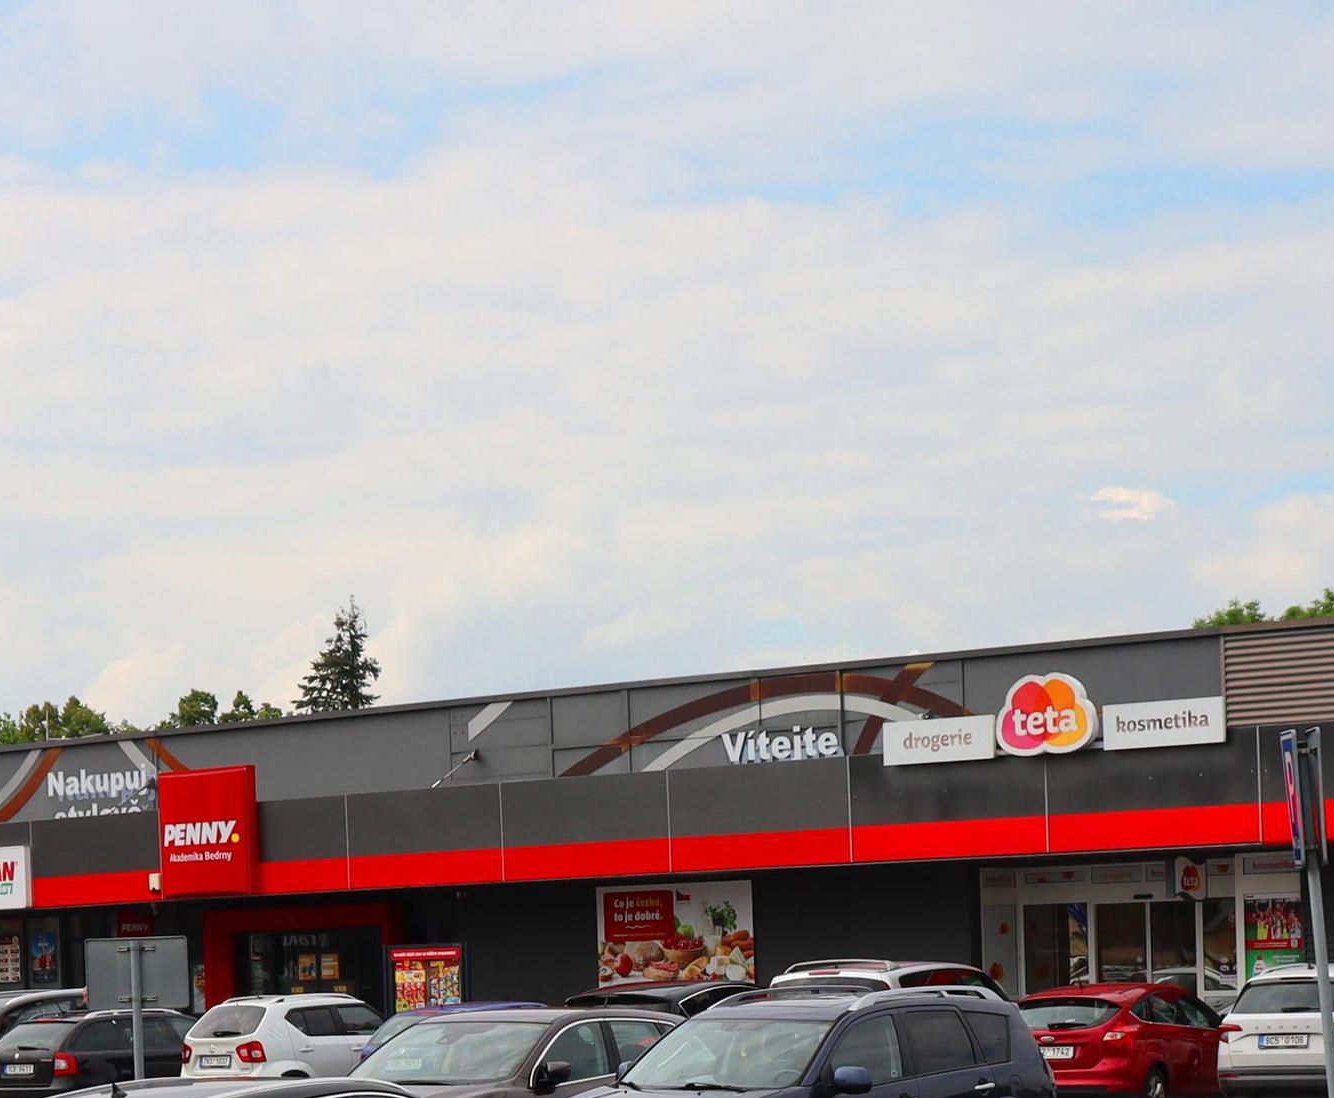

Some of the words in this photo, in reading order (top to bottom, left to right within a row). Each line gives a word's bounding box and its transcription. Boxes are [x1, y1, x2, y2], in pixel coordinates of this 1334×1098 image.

[1012, 705, 1078, 737] teta
[1115, 710, 1210, 733] kosmetika
[721, 725, 840, 765] Vítejte
[903, 728, 973, 752] drogerie
[47, 763, 148, 798] Nakupuj
[169, 852, 204, 863] Akademika
[204, 851, 233, 862] Bedrny
[614, 898, 625, 908] Co
[626, 897, 635, 910] je
[614, 911, 624, 922] to
[624, 910, 633, 923] je
